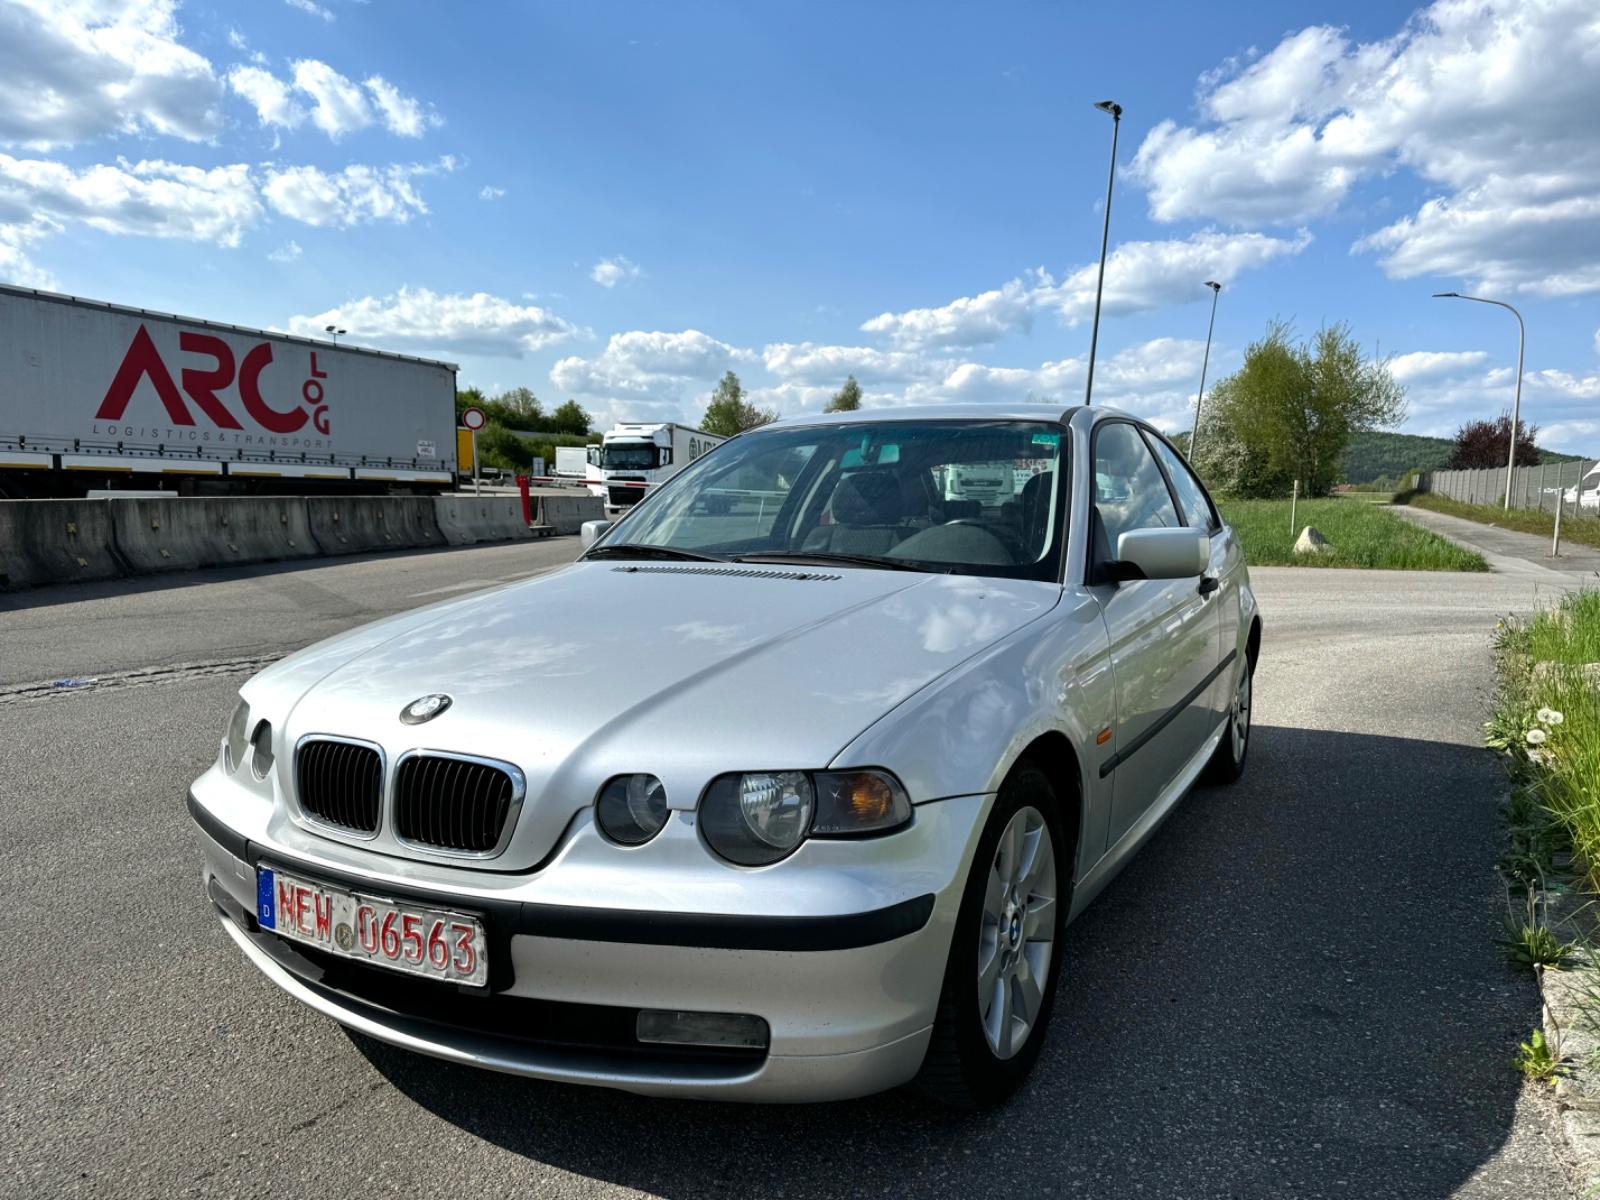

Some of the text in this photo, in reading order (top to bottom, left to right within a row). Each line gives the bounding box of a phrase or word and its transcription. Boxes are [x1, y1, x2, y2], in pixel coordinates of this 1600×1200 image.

[95, 323, 310, 434] ARC
[302, 351, 330, 436] LOG
[263, 904, 270, 917] D
[279, 881, 331, 943] NEW
[357, 904, 475, 975] 06563
